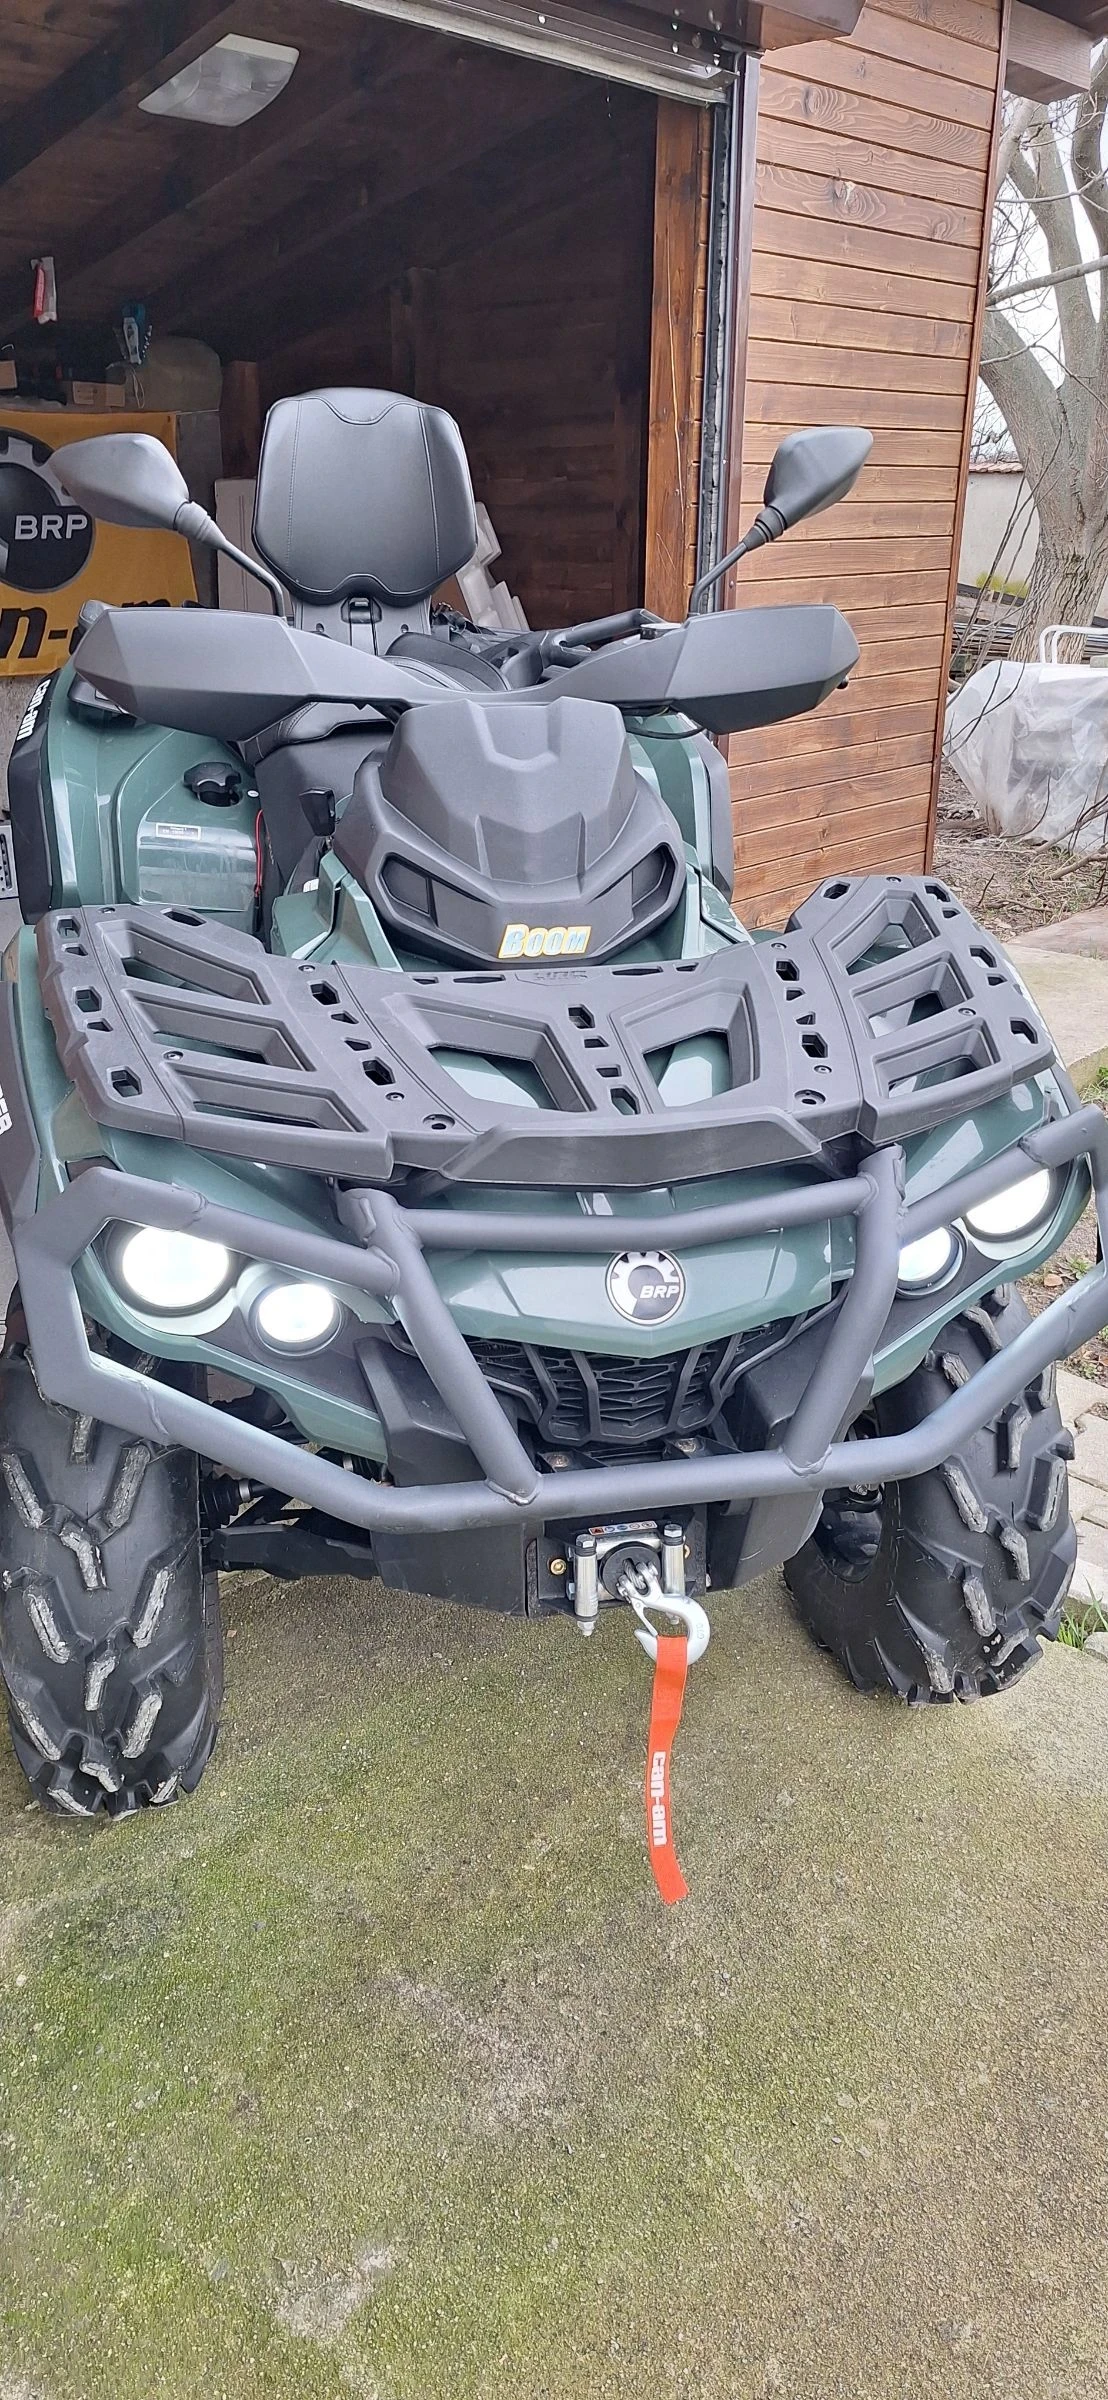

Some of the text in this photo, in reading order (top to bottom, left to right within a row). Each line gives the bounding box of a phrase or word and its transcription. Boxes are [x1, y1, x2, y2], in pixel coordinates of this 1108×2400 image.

[15, 515, 88, 540] BRP
[16, 679, 52, 740] can-am
[498, 923, 592, 959] BOOM
[639, 1284, 680, 1299] BRP
[650, 1751, 667, 1846] can-am
